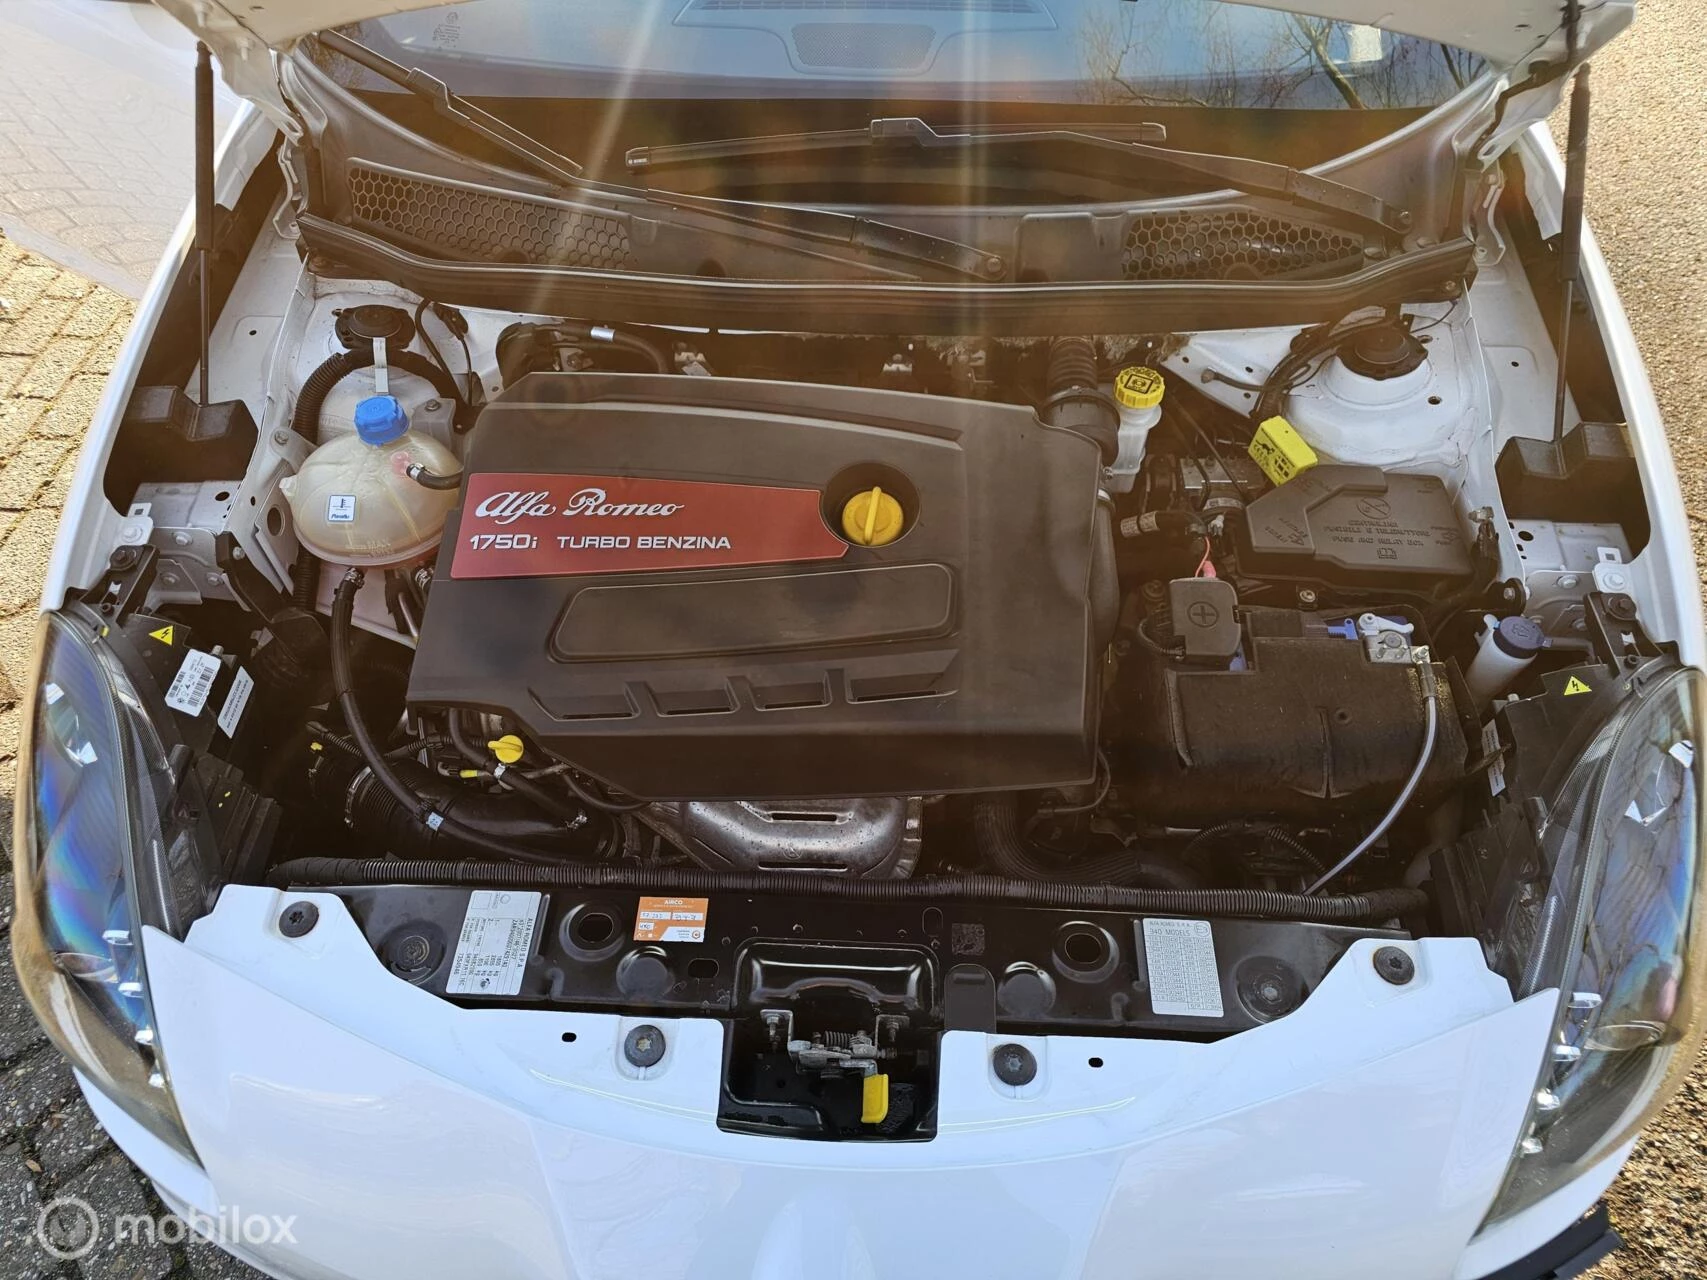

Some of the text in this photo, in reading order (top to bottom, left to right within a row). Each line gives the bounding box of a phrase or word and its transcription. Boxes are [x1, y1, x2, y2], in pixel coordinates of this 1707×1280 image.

[475, 488, 686, 524] Alfa Romeo
[470, 534, 732, 550] 1750i TURBO BENZINA
